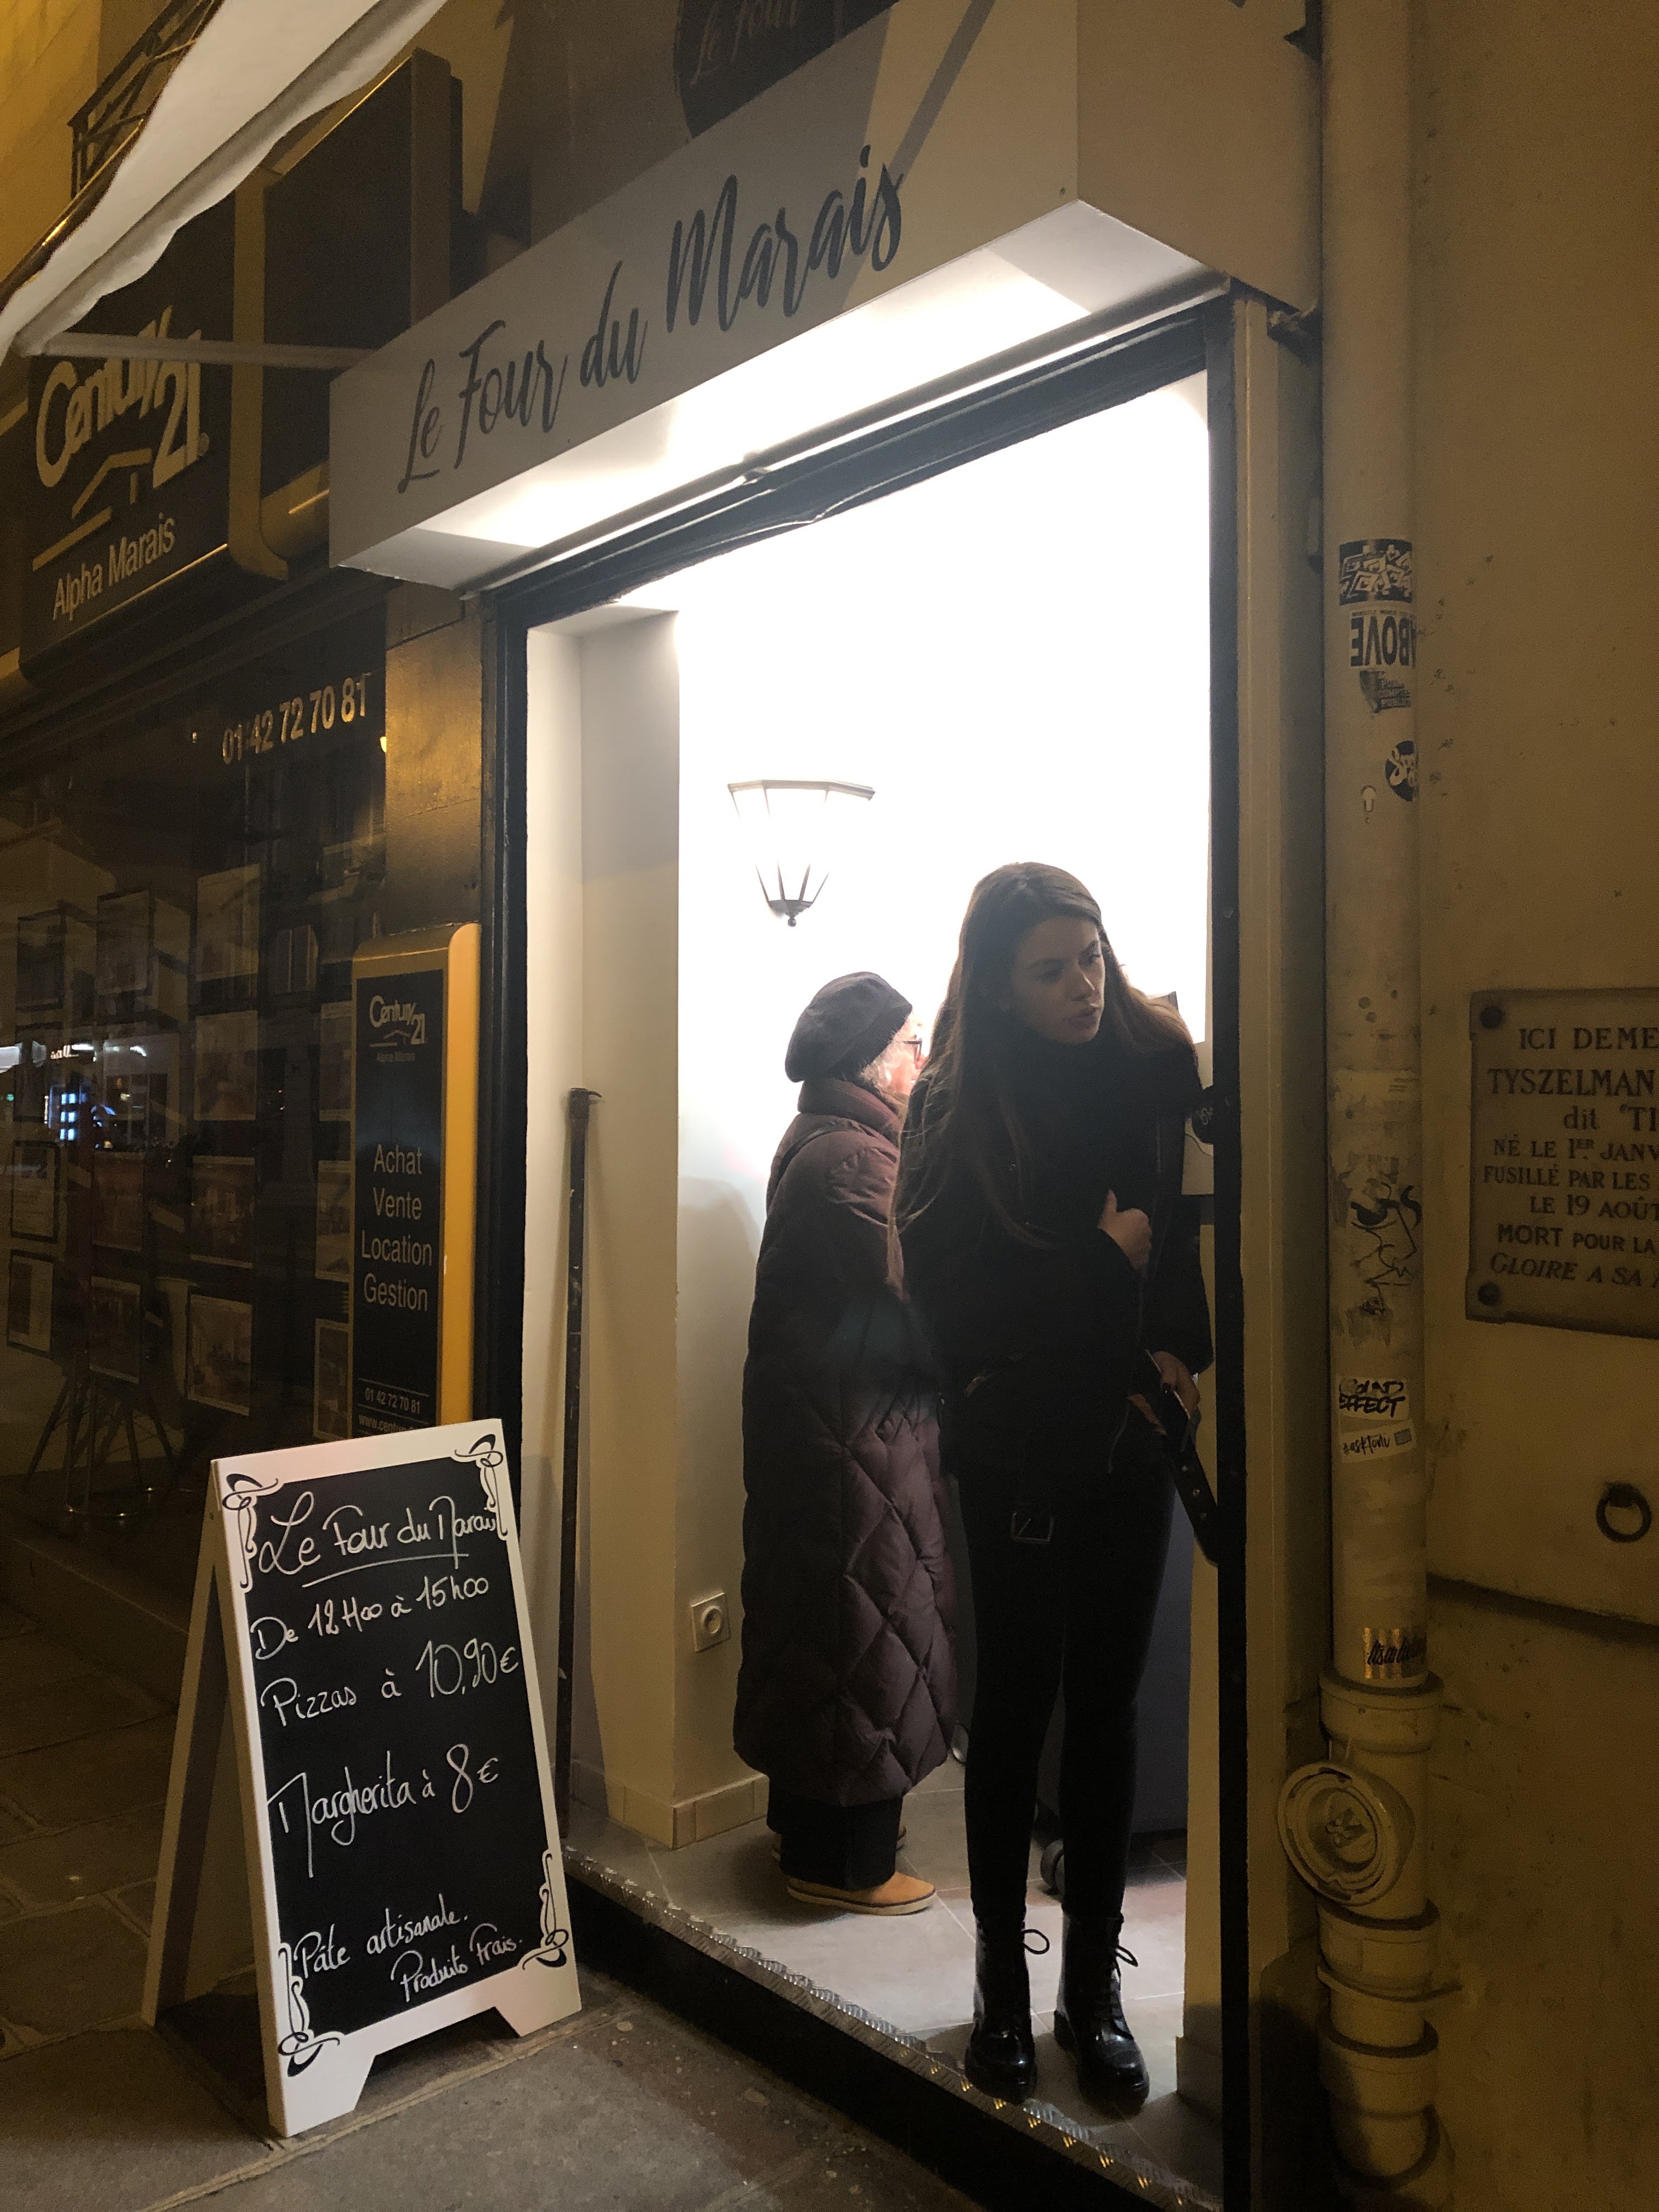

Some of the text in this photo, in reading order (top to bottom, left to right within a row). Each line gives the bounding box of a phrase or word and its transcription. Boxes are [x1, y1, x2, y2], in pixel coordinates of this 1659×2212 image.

[397, 144, 905, 494] Le Four du Marais
[153, 329, 202, 489] 21
[53, 512, 176, 622] Alpha Marais
[222, 674, 369, 764] 01 42 72 70 81
[369, 995, 426, 1045] Century 21
[1519, 1027, 1659, 1050] ICI DEME
[1487, 1068, 1655, 1097] TYSZELMAN
[1564, 1105, 1600, 1130] dit
[373, 1144, 422, 1175] Achat
[1493, 1134, 1520, 1157] NÉ
[1531, 1140, 1557, 1159] LE
[1483, 1163, 1651, 1191] FUSILLÉ PAR LES
[373, 1187, 422, 1221] Vente
[1530, 1194, 1659, 1221] LE 19 AOÛT
[361, 1229, 433, 1267] Location
[1498, 1223, 1656, 1255] MORT POUR LA
[1490, 1252, 1578, 1282] GLOIRE
[1585, 1266, 1603, 1284] A
[1611, 1266, 1642, 1287] SA
[363, 1272, 428, 1312] Gestion
[364, 1387, 421, 1415] 01 42 72 70 81
[1339, 1393, 1406, 1418] EFFECT
[258, 1491, 321, 1576] Le
[322, 1505, 389, 1557] Four
[396, 1507, 431, 1544] du
[250, 1616, 299, 1660] De
[390, 1595, 411, 1619] à
[261, 1677, 357, 1726] Pizzas
[380, 1668, 402, 1699] à
[267, 1750, 416, 1878] Margherita
[421, 1769, 436, 1798] à
[390, 1944, 469, 2002] Produits
